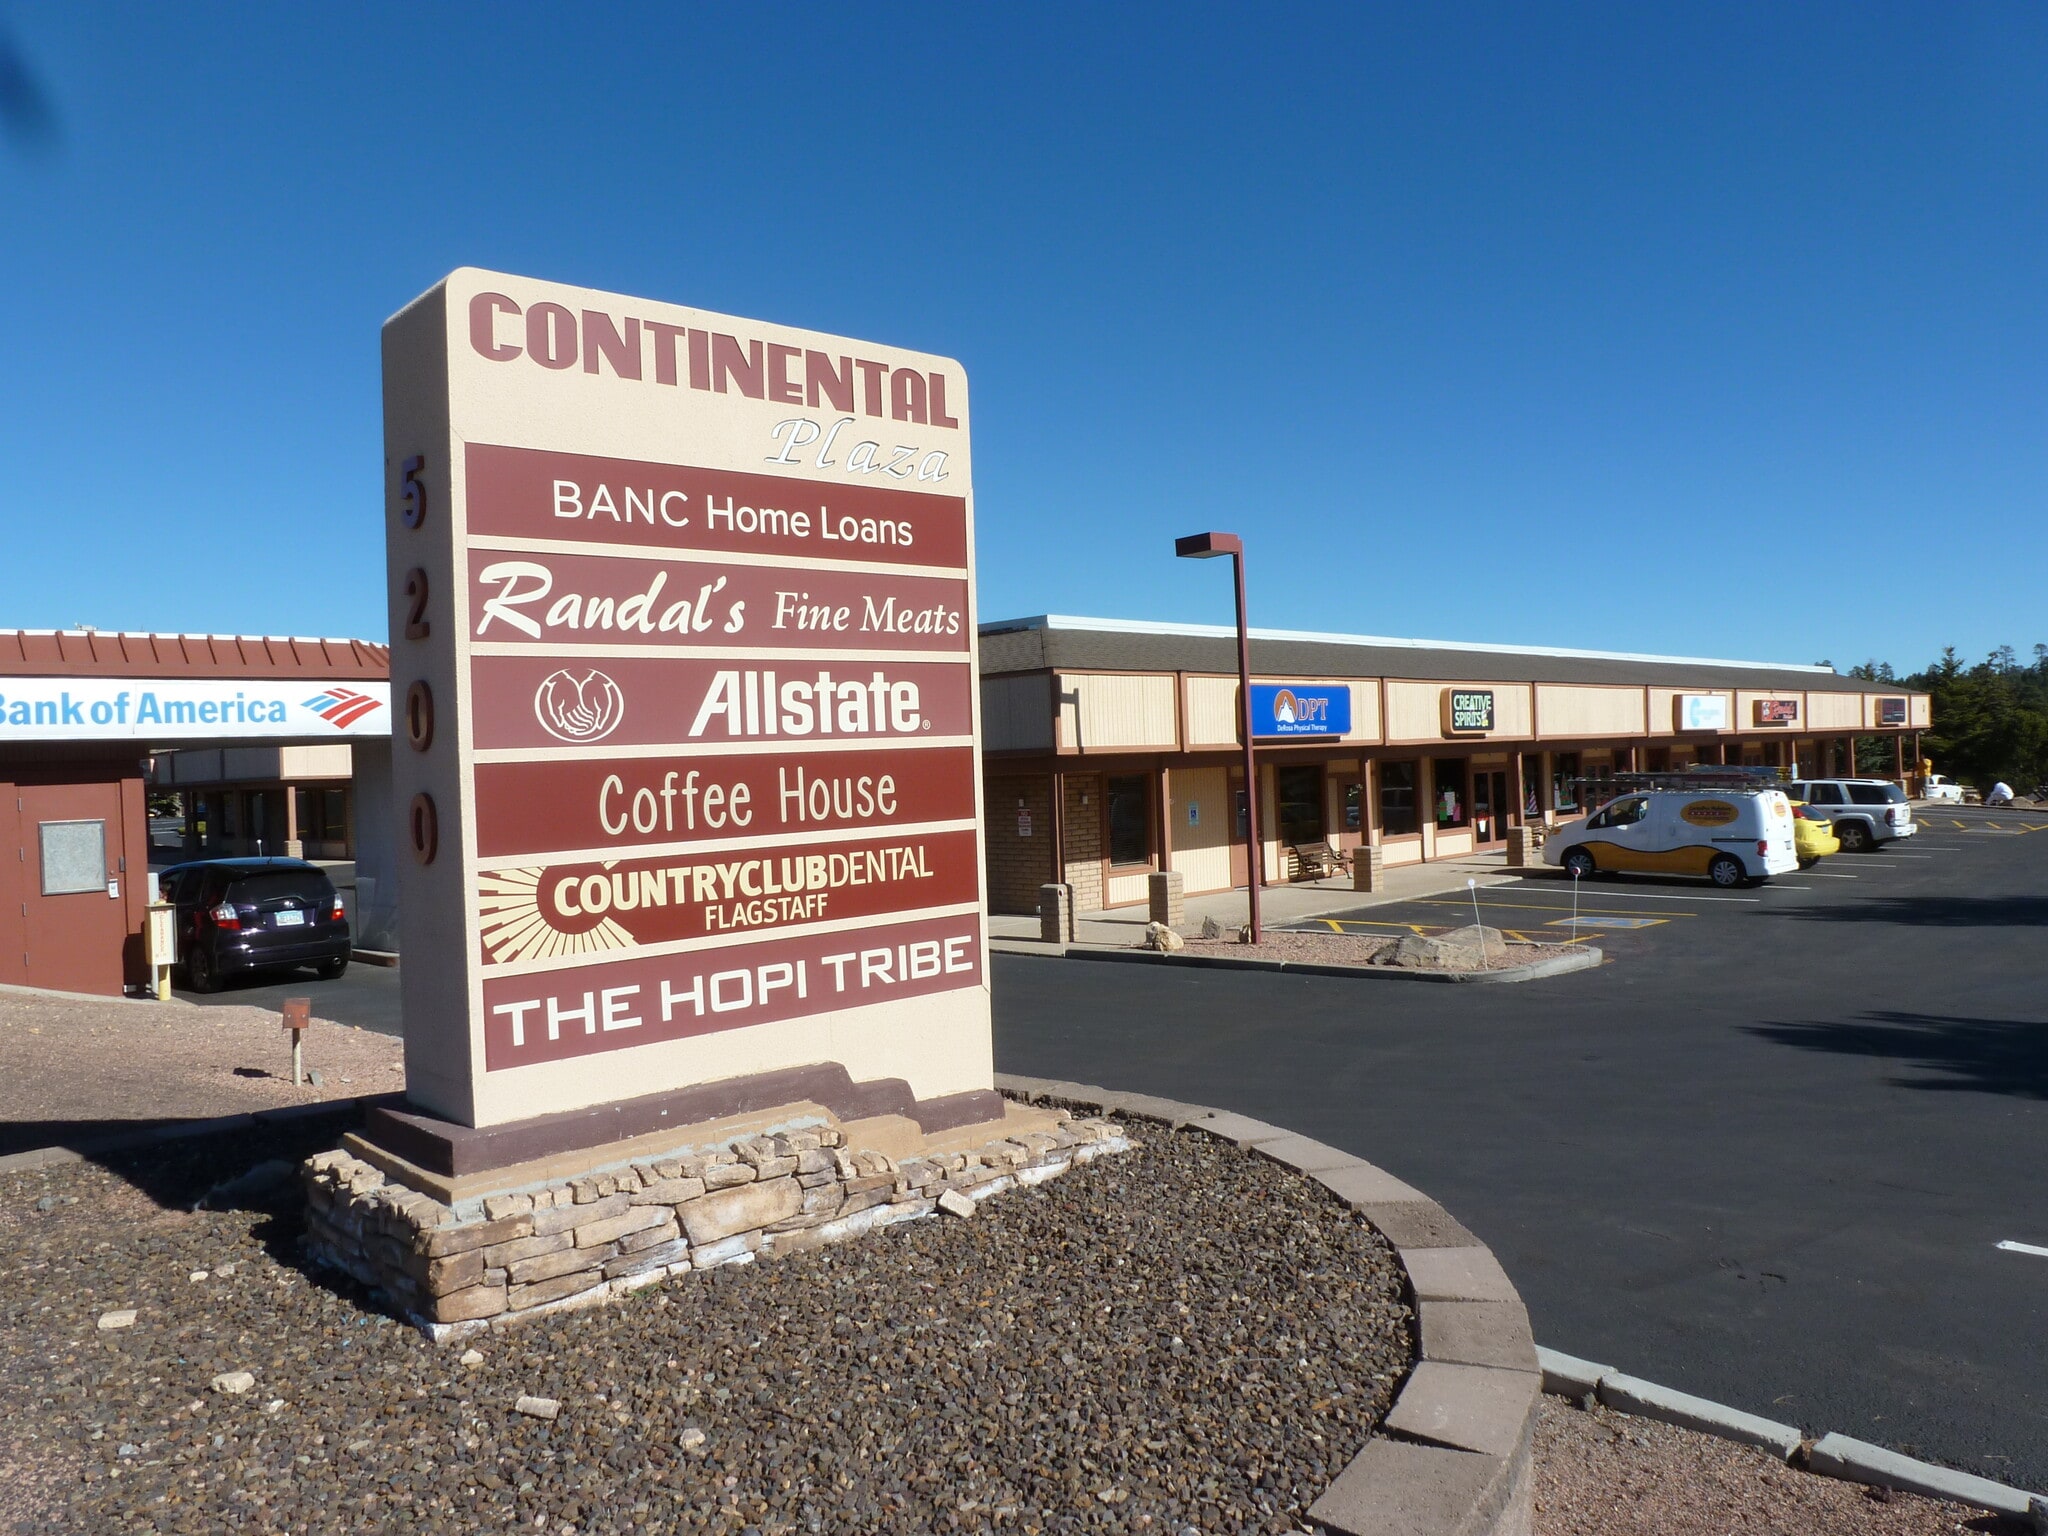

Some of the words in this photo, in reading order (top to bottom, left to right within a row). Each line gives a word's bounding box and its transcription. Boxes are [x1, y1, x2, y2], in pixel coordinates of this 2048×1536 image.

[469, 292, 959, 429] CONTINENTAL
[764, 417, 950, 482] Plaza
[553, 480, 689, 527] BANC
[707, 495, 810, 537] Home
[821, 506, 914, 546] Loans
[476, 561, 746, 639] Randal's
[771, 591, 850, 631] Fine
[860, 596, 960, 635] Meats
[0, 691, 84, 725] ank
[91, 692, 130, 725] of
[136, 692, 287, 724] America
[1294, 724, 1311, 732] Physical
[1311, 724, 1328, 732] Therapy
[1453, 694, 1492, 710] CREATIVE
[1454, 711, 1482, 727] SPIRITS
[599, 771, 752, 835] Coffee
[779, 766, 897, 823] House
[705, 893, 828, 931] FLAGSTAFF
[493, 984, 642, 1046] THE
[660, 960, 807, 1022] HOPI
[821, 935, 974, 992] TRIBE
